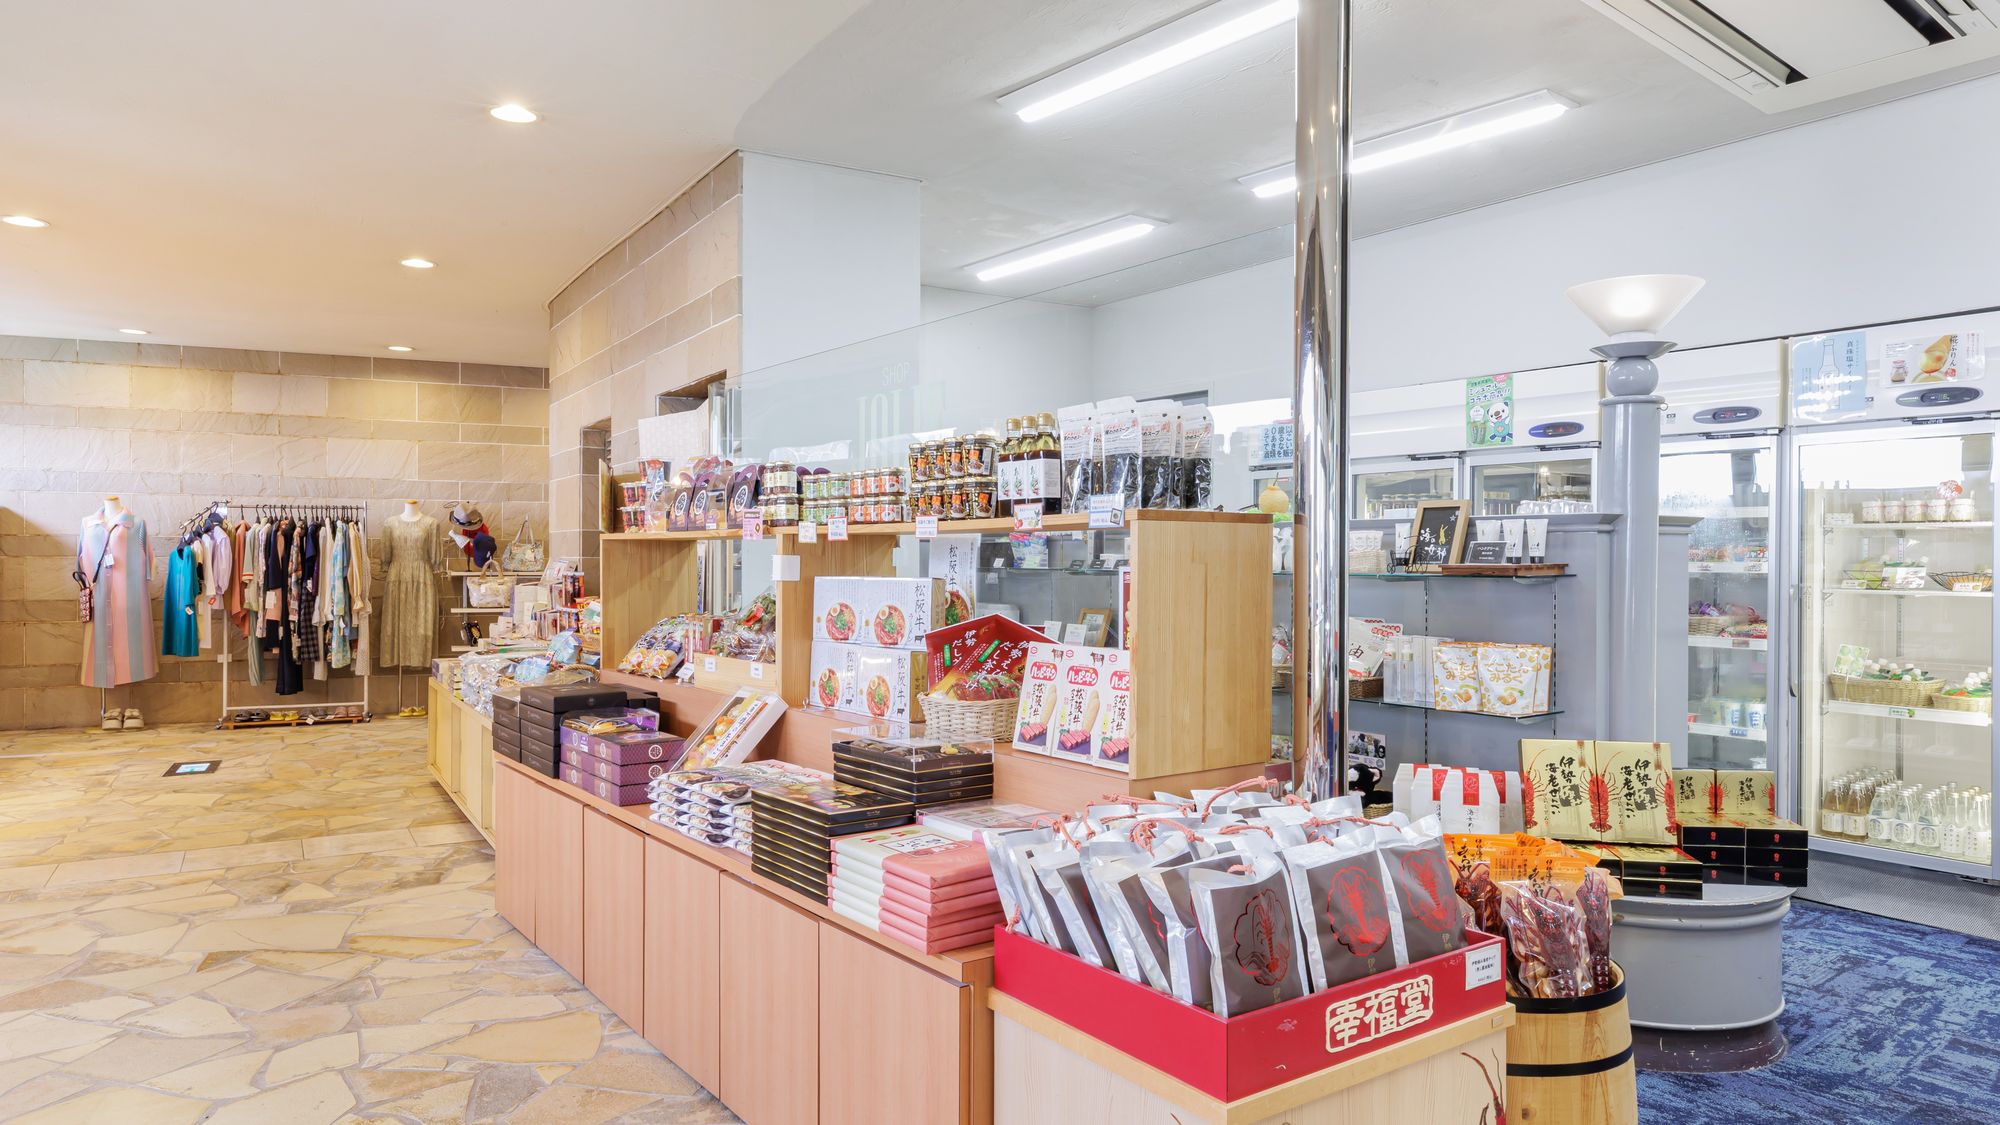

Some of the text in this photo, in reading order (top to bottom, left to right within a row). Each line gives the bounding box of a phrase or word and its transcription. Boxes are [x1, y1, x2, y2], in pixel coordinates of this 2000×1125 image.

[881, 361, 911, 386] SHOP
[1845, 340, 1855, 391] 真珠塩サイー
[948, 544, 958, 590] 松阪牛
[914, 583, 926, 631] 松阪牛
[896, 655, 906, 703] 松阪牛
[1068, 670, 1098, 685] ハッピーターン
[1488, 673, 1523, 684] みるく
[1073, 688, 1086, 724] 松阪牛
[1116, 694, 1128, 731] 松阪牛
[1559, 755, 1577, 785] 伊勢
[1634, 758, 1652, 788] 伊勢
[1327, 977, 1432, 1050] 幸福堂
